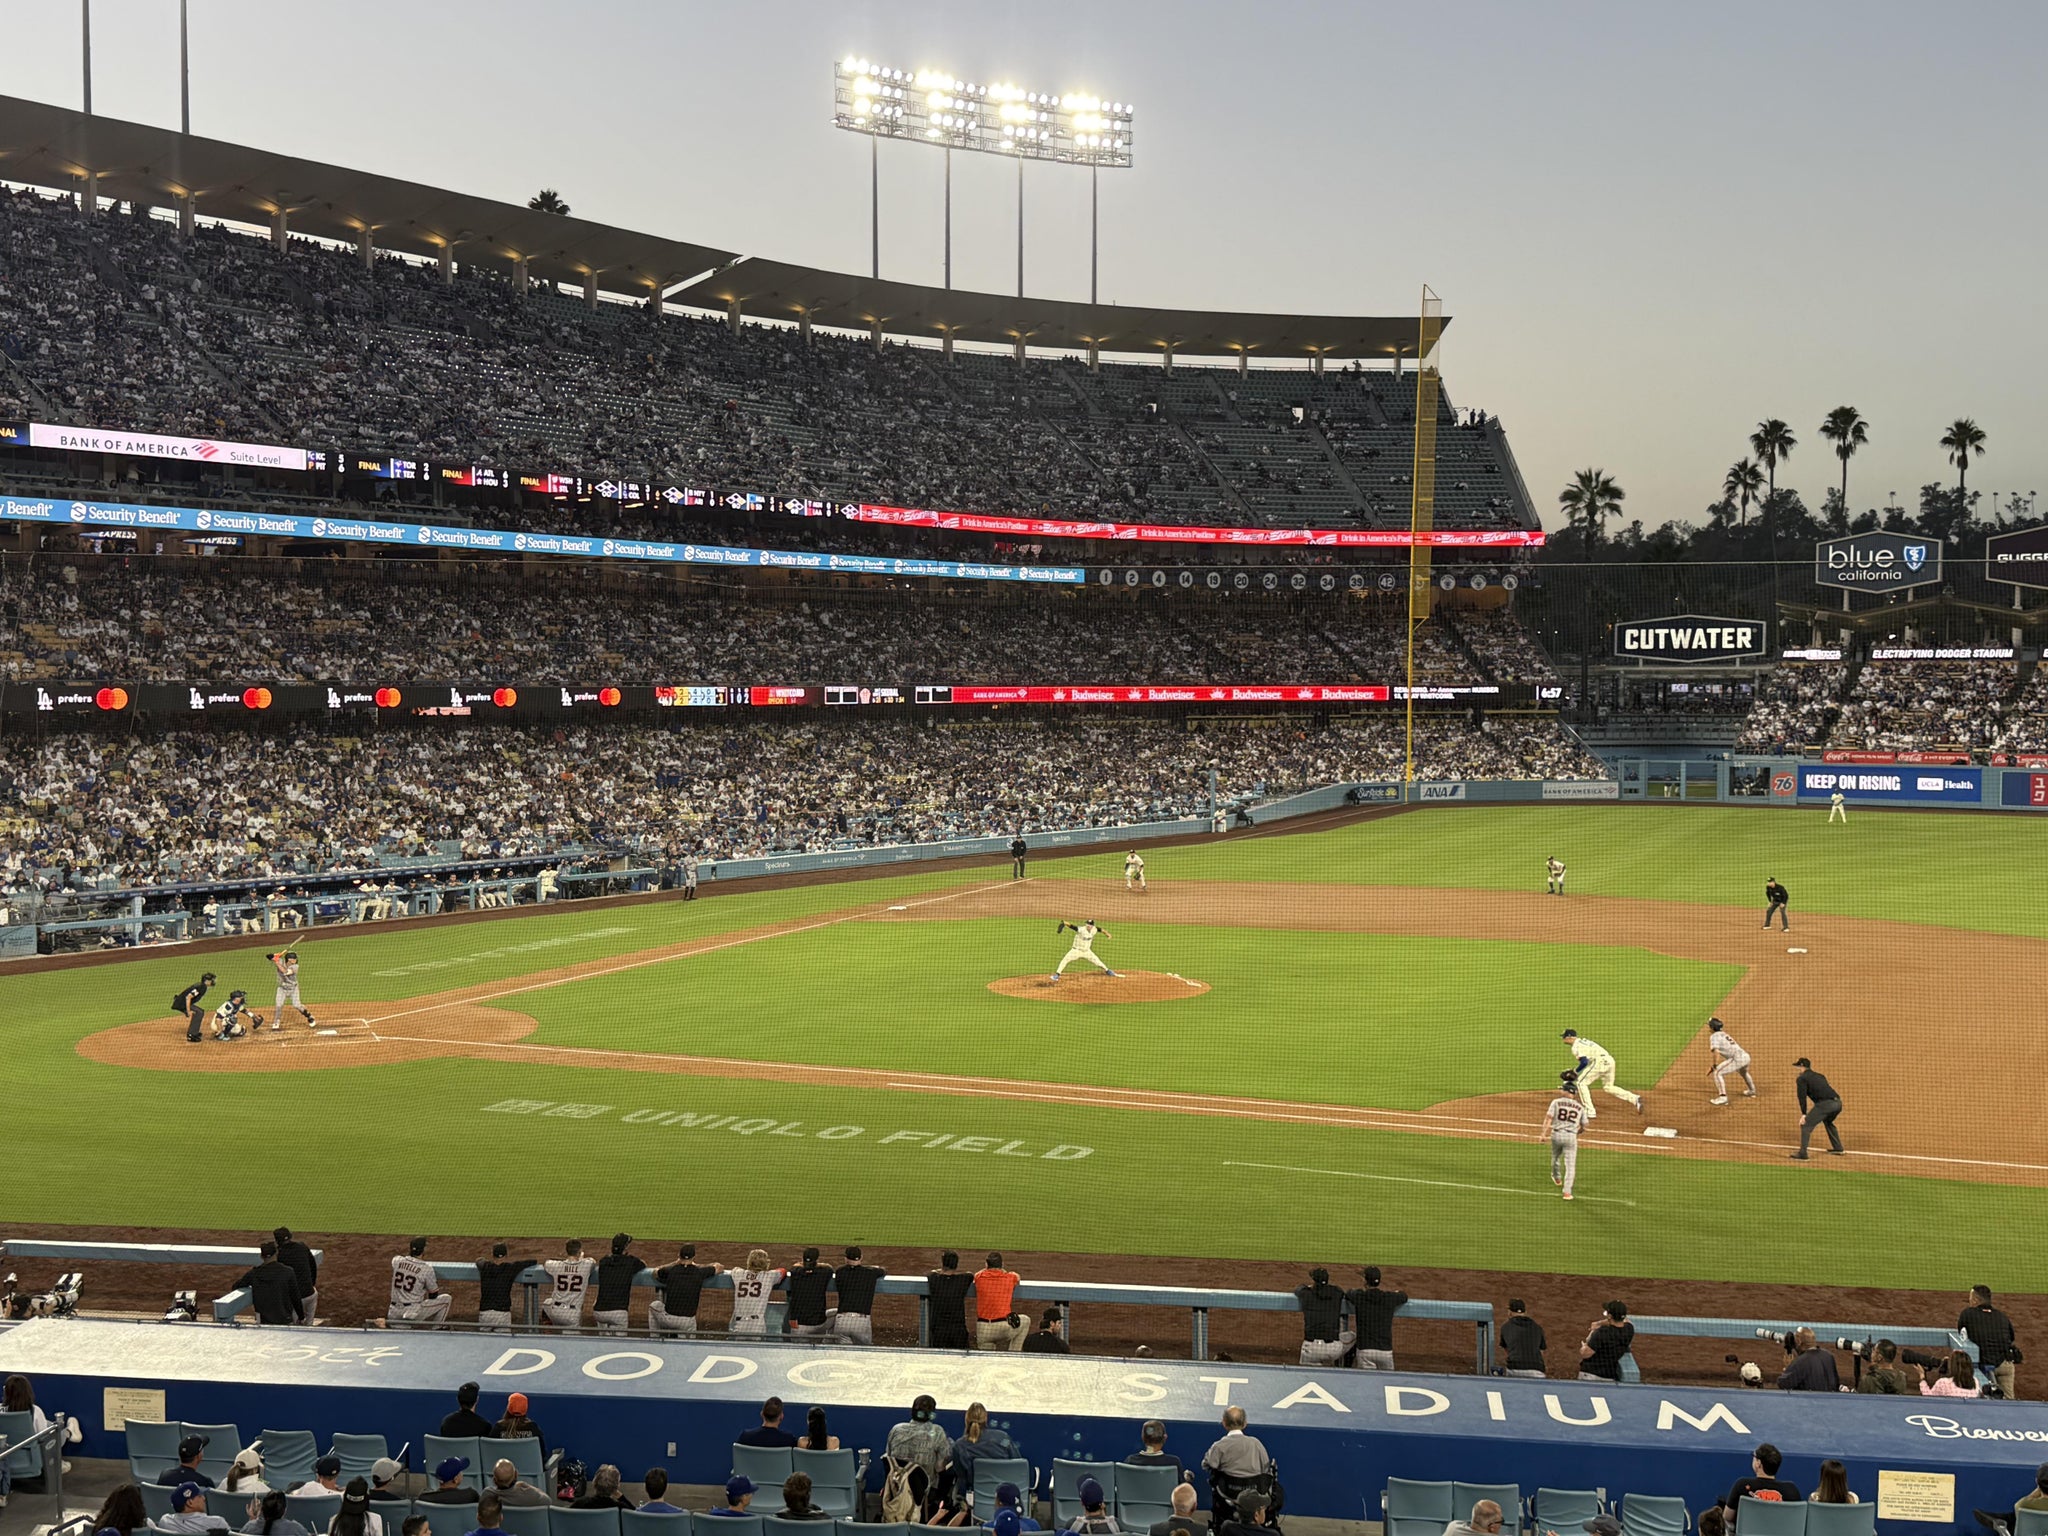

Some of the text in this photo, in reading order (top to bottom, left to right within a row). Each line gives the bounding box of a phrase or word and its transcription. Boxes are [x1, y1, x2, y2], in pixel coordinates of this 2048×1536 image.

[60, 436, 189, 456] BANK OF AMERICA
[230, 452, 281, 465] Suite Level
[316, 453, 344, 463] KC 5
[316, 462, 345, 473] PIT 6
[358, 461, 382, 471] FINAL
[402, 461, 429, 471] TOR 2
[403, 470, 430, 481] TEX 6
[442, 469, 463, 479] FINAL
[483, 469, 508, 478] ATL 6
[483, 478, 508, 488] HOU 3
[520, 477, 540, 486] FINAL
[559, 477, 582, 486] WSH 3
[577, 487, 582, 495] 2
[645, 485, 650, 493] 3
[628, 491, 640, 500] COL
[709, 499, 715, 507] 0
[7, 501, 50, 517] Benefit
[89, 506, 178, 525] Security Benefit
[214, 515, 295, 532] Security Benefit
[328, 523, 403, 539] Security Benefit
[432, 530, 501, 546] Security Benefit
[528, 537, 591, 552] Security Benefit
[615, 544, 674, 558] Security Benefit
[695, 550, 750, 563] Security Benefit
[1828, 544, 1895, 569] blue
[770, 555, 821, 568] Security Benefit
[966, 567, 1012, 579] Security Benefit
[1028, 569, 1077, 580] Security Benefit
[1838, 569, 1902, 581] california
[1181, 574, 1190, 584] 14
[1209, 575, 1218, 585] 19
[1236, 576, 1247, 586] 20
[1265, 576, 1276, 586] 24
[1293, 576, 1304, 586] 32
[1322, 577, 1333, 587] 34
[1380, 577, 1392, 587] 42
[1624, 627, 1752, 650] CUTWATER
[1872, 649, 2014, 659] ELECTRIFYING DODGER STADIUM
[37, 687, 92, 710] LA prefers
[189, 687, 240, 709] LA prefers
[327, 687, 372, 708] LA prefers
[450, 687, 491, 707] LA prefers
[561, 687, 598, 706] LA prefers
[1072, 689, 1114, 700] Budweiser
[1148, 690, 1195, 700] Budweiser
[1232, 689, 1282, 699] Budweiser
[1322, 689, 1374, 699] Budweiser
[1541, 687, 1562, 699] 6:57
[1774, 776, 1793, 792] 76
[1806, 774, 1901, 791] KEEP ON RISING
[1945, 780, 1973, 790] Health
[1424, 787, 1447, 798] ANA
[1557, 1108, 1578, 1124] 82
[619, 1109, 866, 1140] UNIQLO
[877, 1130, 1095, 1160] FIELD
[564, 1265, 579, 1274] HILL
[394, 1271, 416, 1293] 23
[556, 1274, 583, 1292] 52
[737, 1281, 762, 1298] 53
[483, 1347, 1752, 1434] DODGER STADIUM
